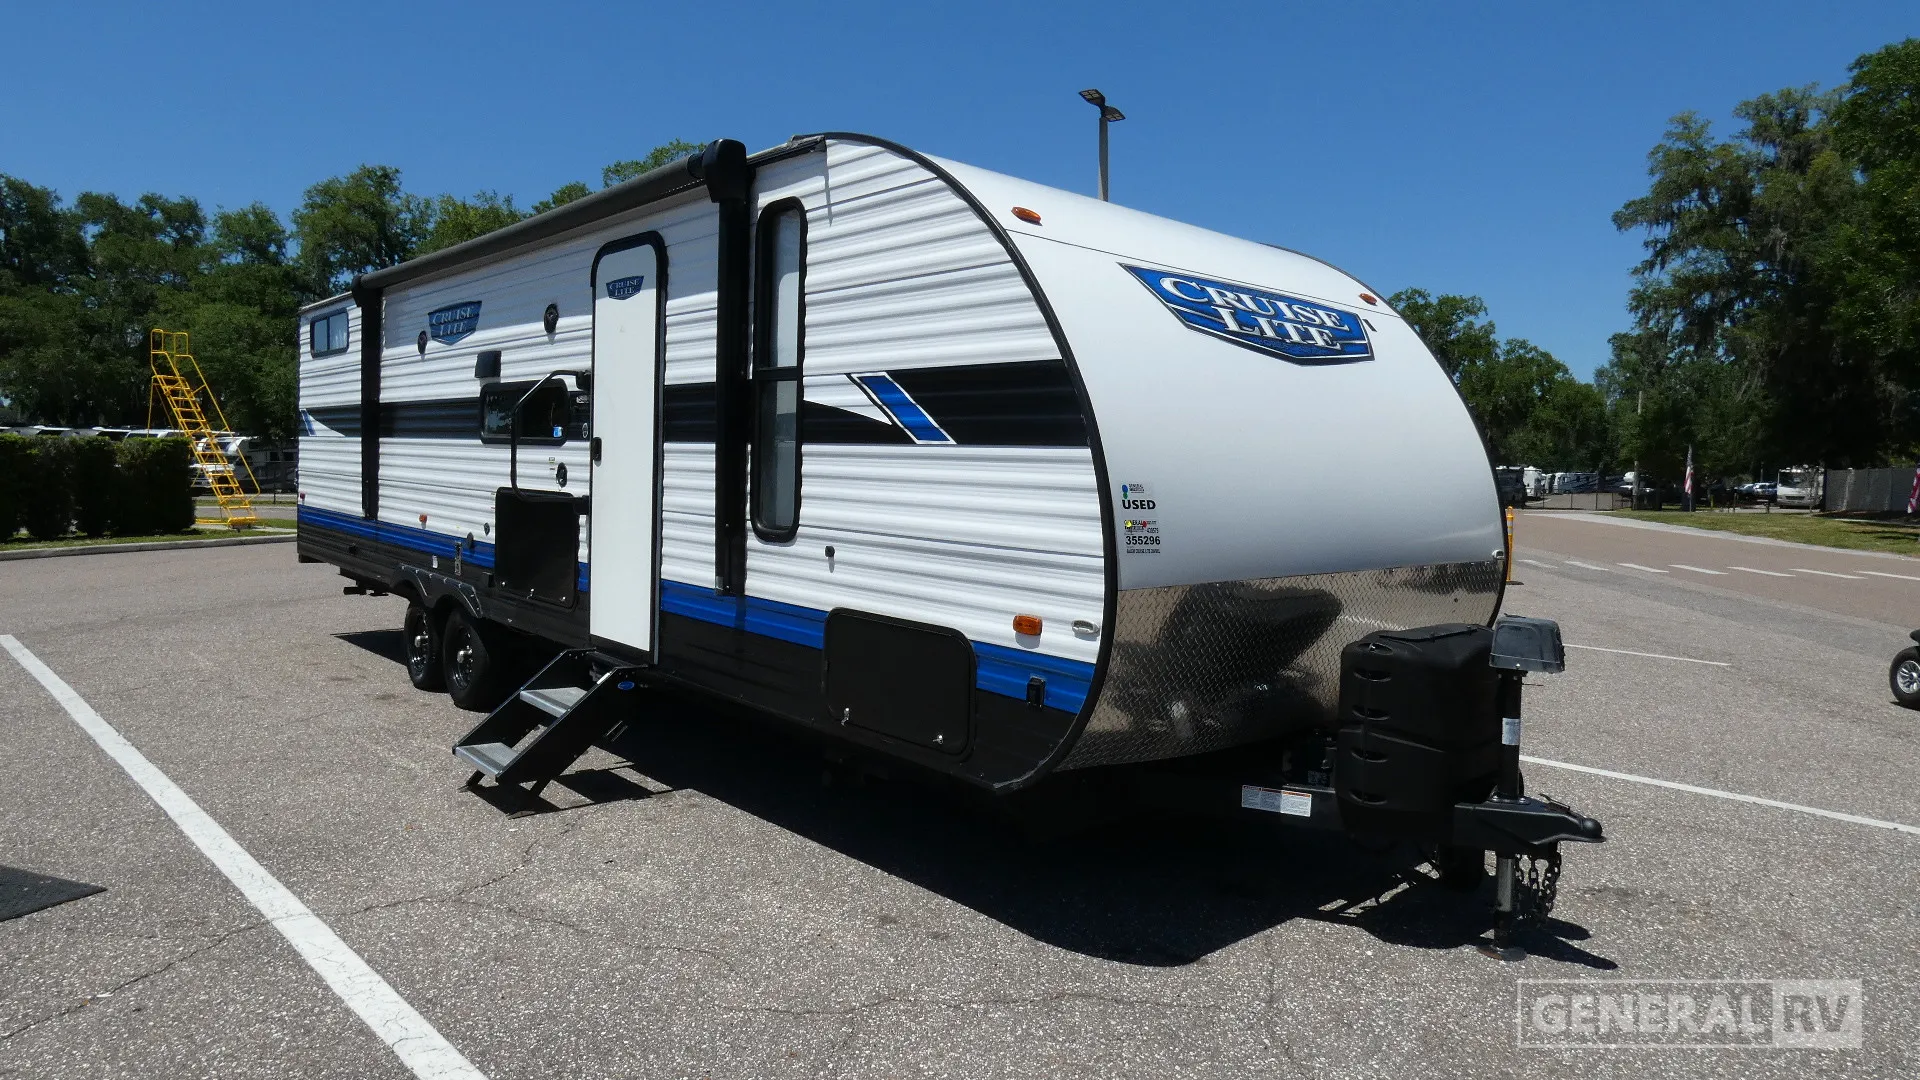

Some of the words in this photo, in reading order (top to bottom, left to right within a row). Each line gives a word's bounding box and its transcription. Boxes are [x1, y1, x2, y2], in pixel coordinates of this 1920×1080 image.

[610, 279, 640, 290] CRUISE
[615, 287, 635, 296] LITE
[1159, 277, 1350, 332] CRUISE
[432, 306, 475, 324] CRUISE
[440, 321, 467, 336] LITE
[1211, 306, 1341, 350] LITE
[1122, 499, 1156, 510] USED
[1126, 535, 1161, 545] 355296
